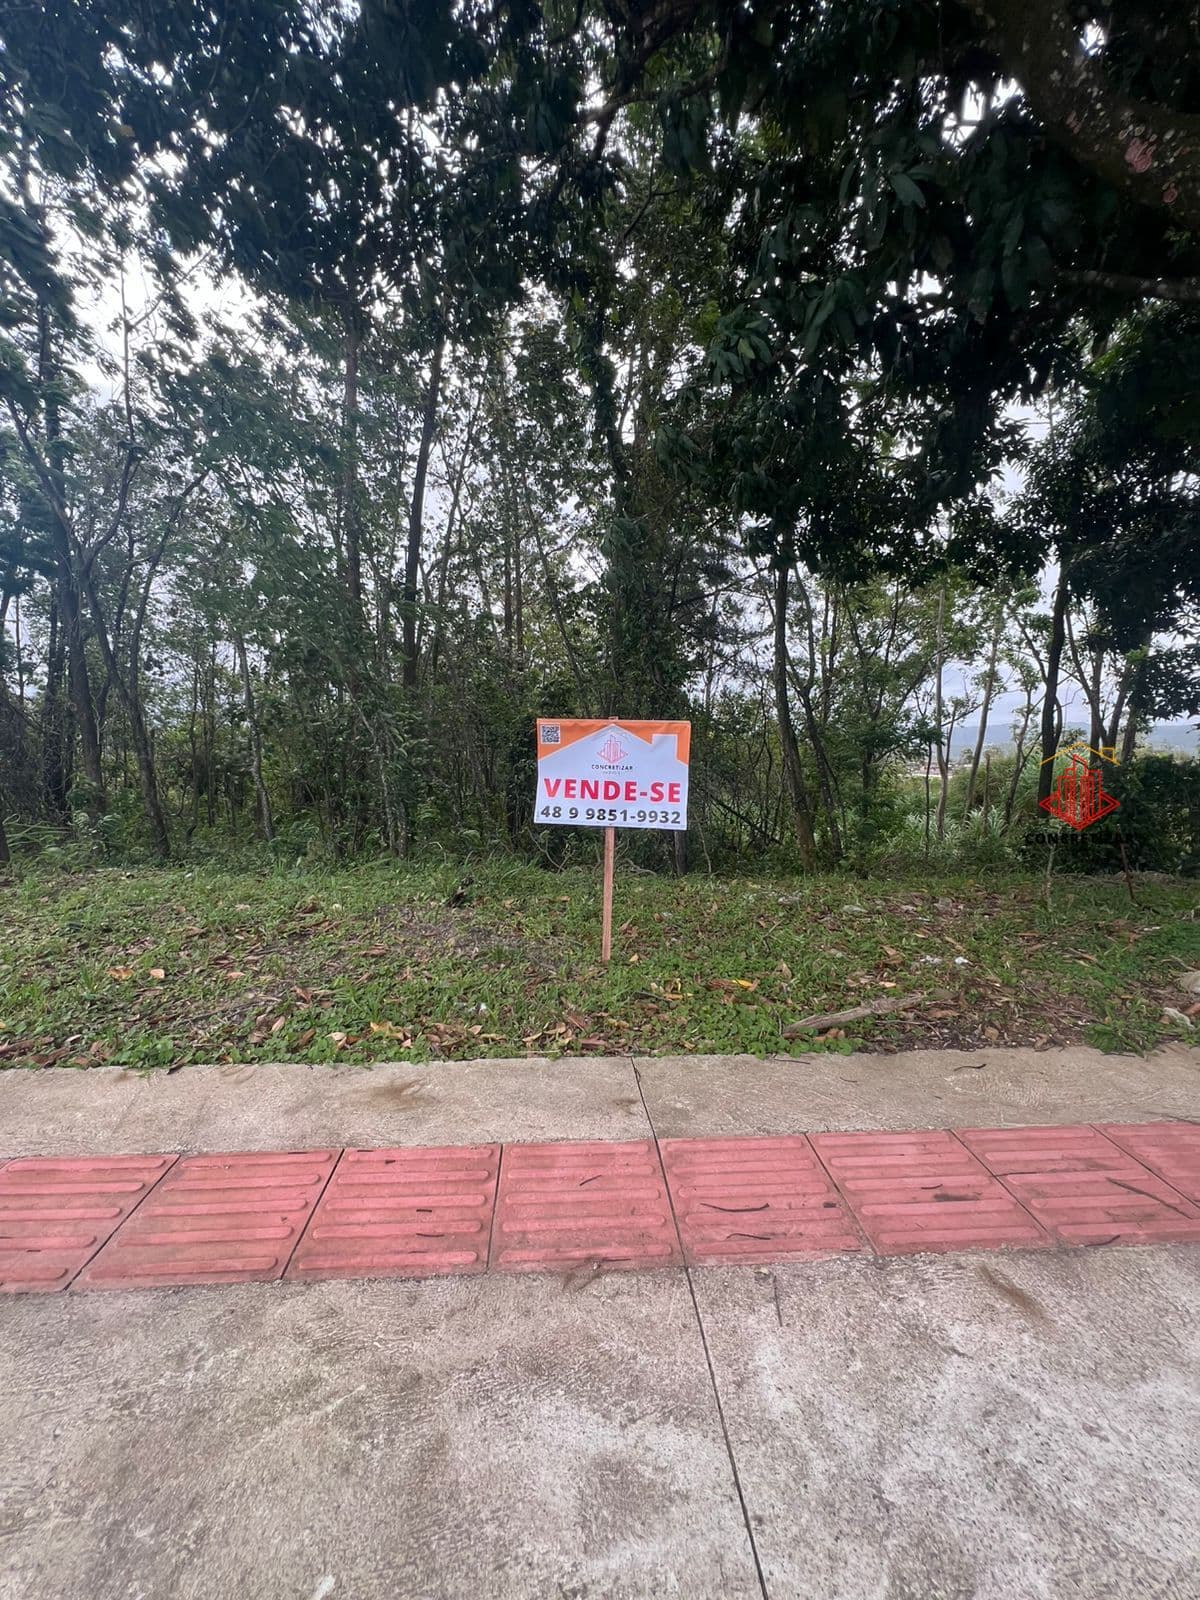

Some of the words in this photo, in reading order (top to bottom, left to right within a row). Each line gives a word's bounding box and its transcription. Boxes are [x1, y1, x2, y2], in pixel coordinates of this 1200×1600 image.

[544, 778, 681, 803] VENDE-SE
[540, 805, 562, 818] 48
[568, 807, 579, 819] 9
[585, 808, 681, 824] 9851-9932
